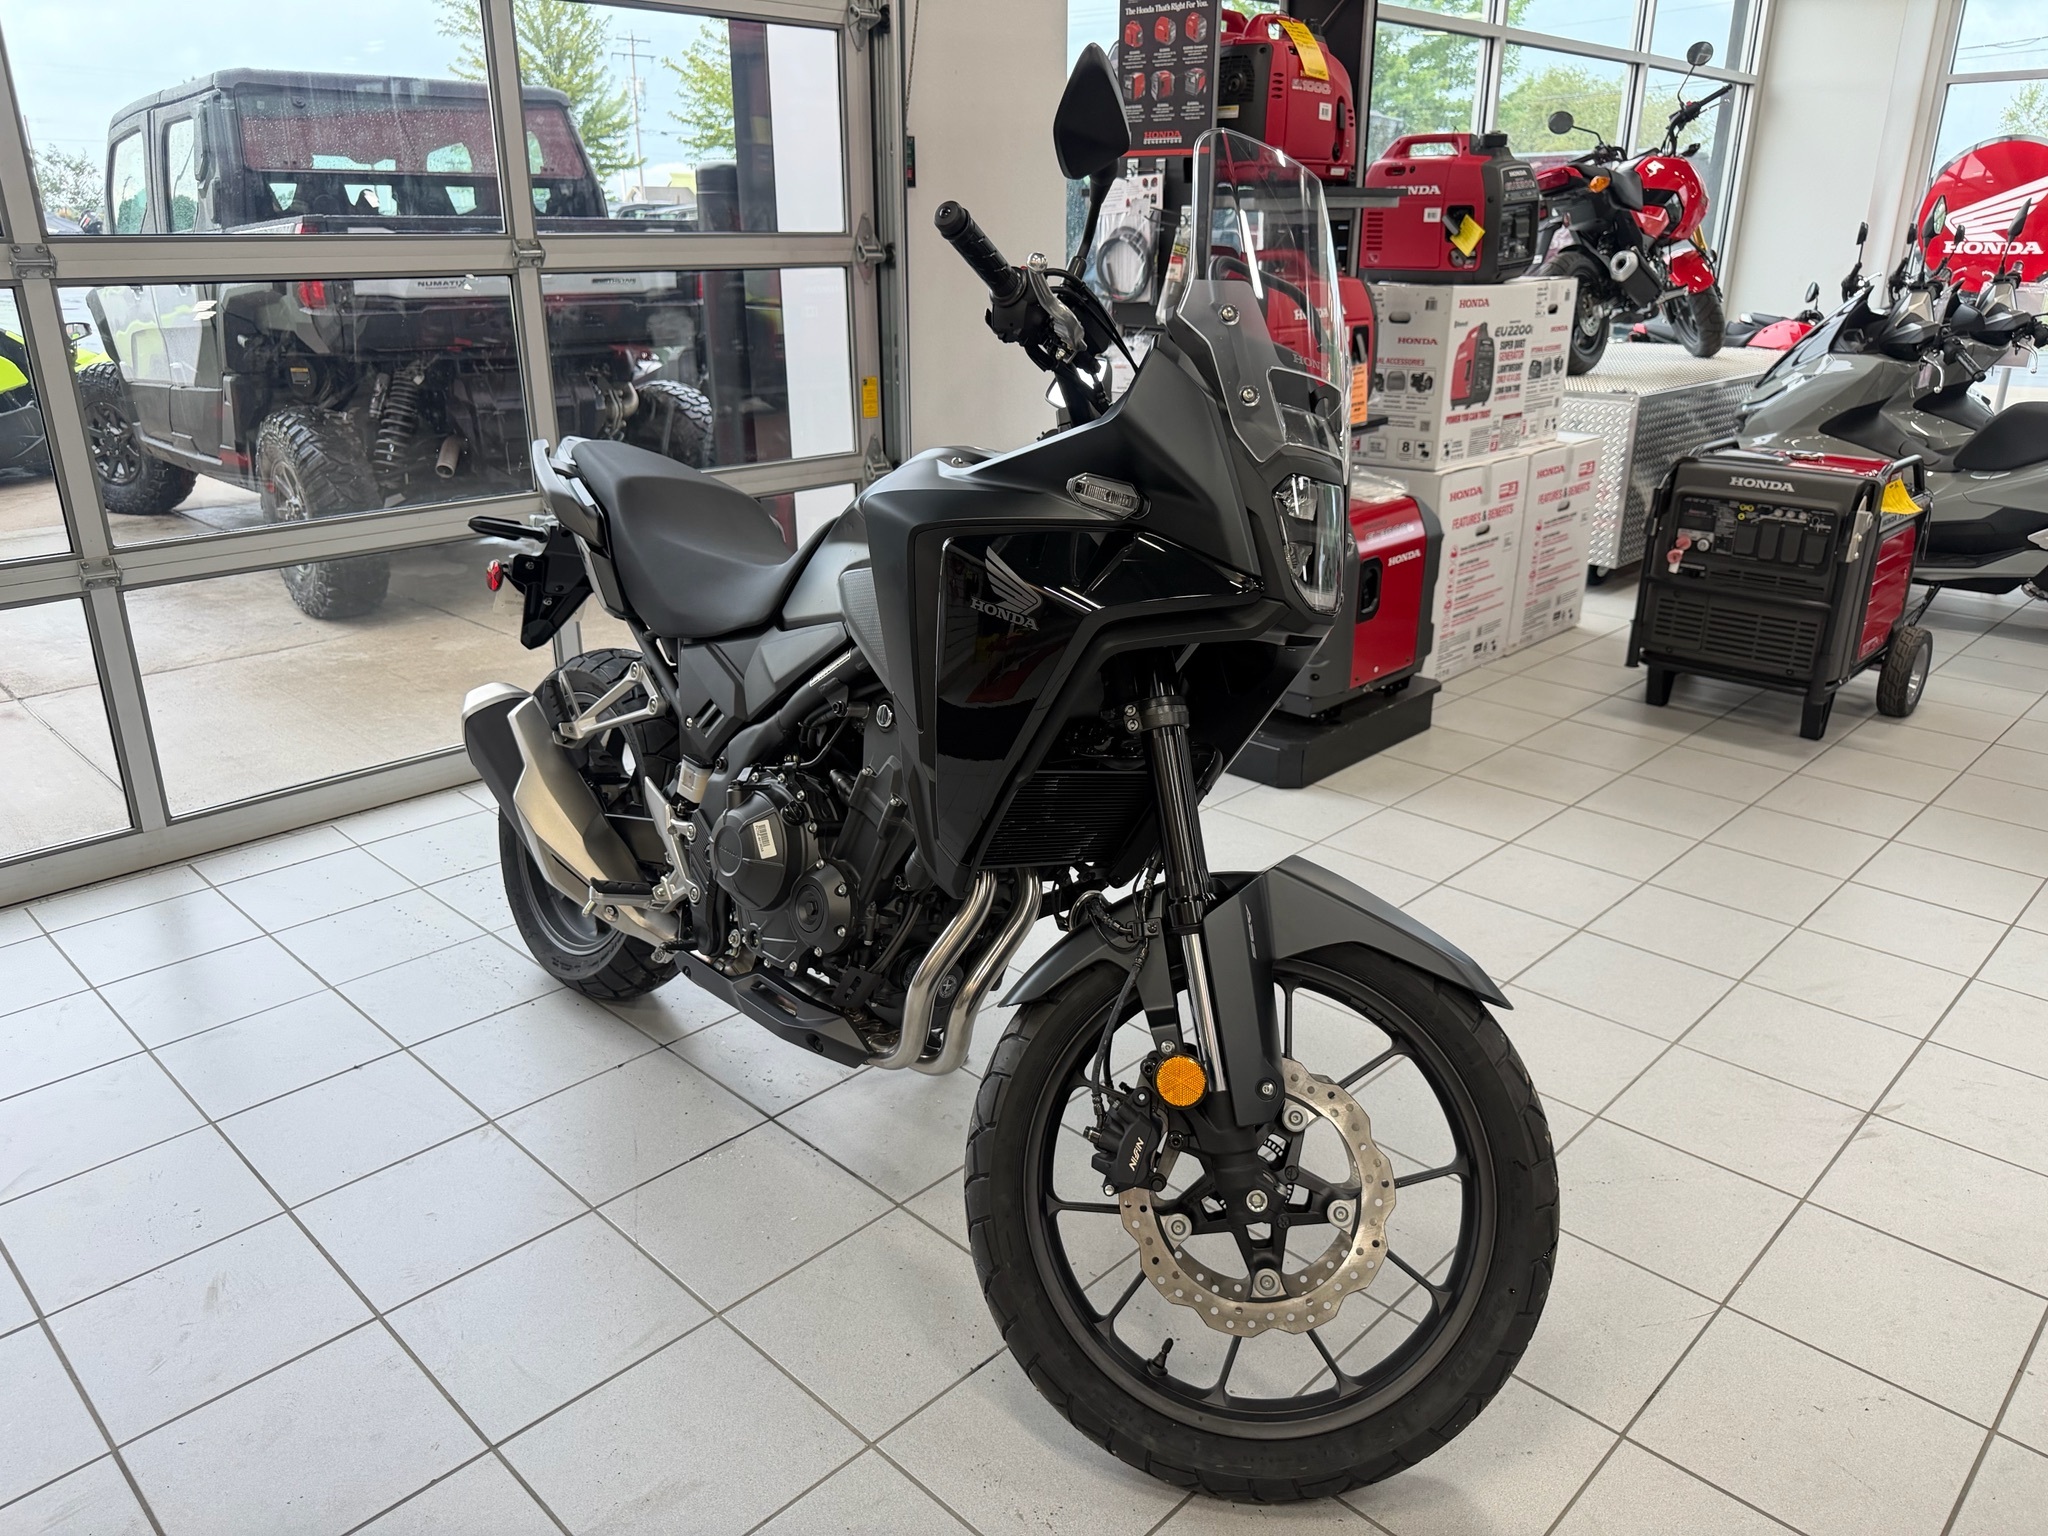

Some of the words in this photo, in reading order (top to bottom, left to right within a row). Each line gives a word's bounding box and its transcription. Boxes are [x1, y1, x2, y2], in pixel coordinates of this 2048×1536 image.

[1125, 8, 1136, 16] The
[1186, 1, 1196, 9] For
[1143, 137, 1182, 145] GENERATORS
[1144, 131, 1181, 139] HONDA
[1508, 169, 1528, 177] HONDA
[1943, 241, 2044, 255] HONDA
[1458, 298, 1490, 309] HONDA
[1397, 336, 1438, 345] HONDA
[1402, 441, 1410, 453] 8
[1537, 464, 1565, 479] HONDA
[1728, 476, 1795, 493] HONDA
[1449, 486, 1483, 502] HONDA
[1387, 549, 1421, 567] HONDA
[970, 597, 1039, 631] HONDA
[1128, 1136, 1145, 1172] NISSIN
